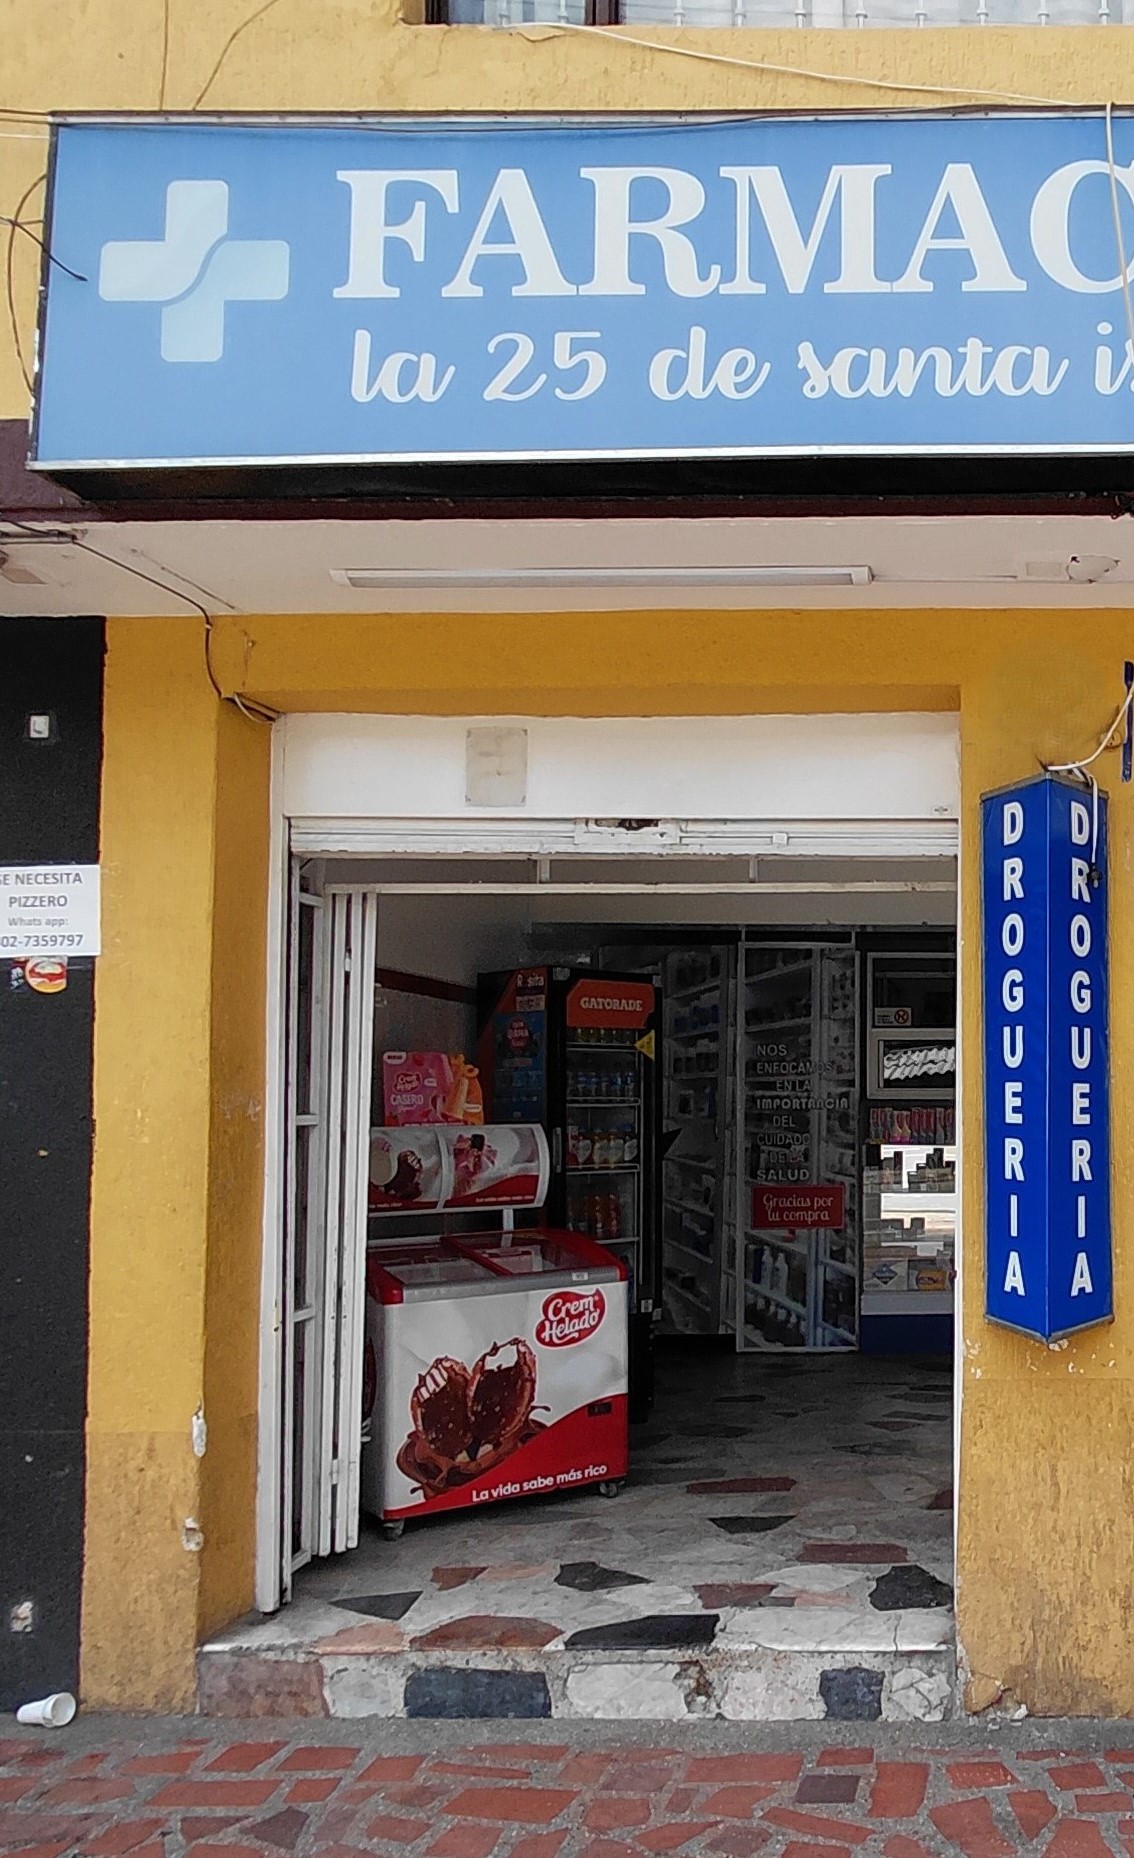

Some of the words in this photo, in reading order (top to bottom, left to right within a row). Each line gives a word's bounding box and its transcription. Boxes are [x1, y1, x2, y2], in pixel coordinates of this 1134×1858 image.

[350, 329, 456, 404] la
[484, 331, 608, 402] 25
[648, 325, 770, 401] de
[797, 335, 1068, 399] santa
[15, 872, 83, 885] NECESITA
[9, 895, 68, 908] PIZZERO
[8, 917, 42, 926] Whats
[580, 997, 643, 1012] GATORADE
[757, 1044, 788, 1057] NOS
[1002, 801, 1026, 1297] DROGUERIA
[1070, 801, 1094, 1297] DROGUERIA
[757, 1061, 834, 1075] ENFOCAMOS
[776, 1080, 793, 1092] EN
[796, 1080, 811, 1092] LA
[773, 1115, 795, 1127] DEL
[757, 1133, 811, 1146] CUIDADO
[769, 1152, 785, 1164] DE
[757, 1168, 810, 1181] SALUD
[763, 1193, 812, 1211] Gracias
[814, 1195, 835, 1210] por
[783, 1209, 830, 1225] compra
[548, 1296, 594, 1322] Crem
[541, 1308, 600, 1344] Helado
[472, 1489, 489, 1502] La
[491, 1482, 520, 1498] vida
[522, 1475, 554, 1491] sabe
[556, 1468, 583, 1484] más
[584, 1464, 608, 1478] rico
